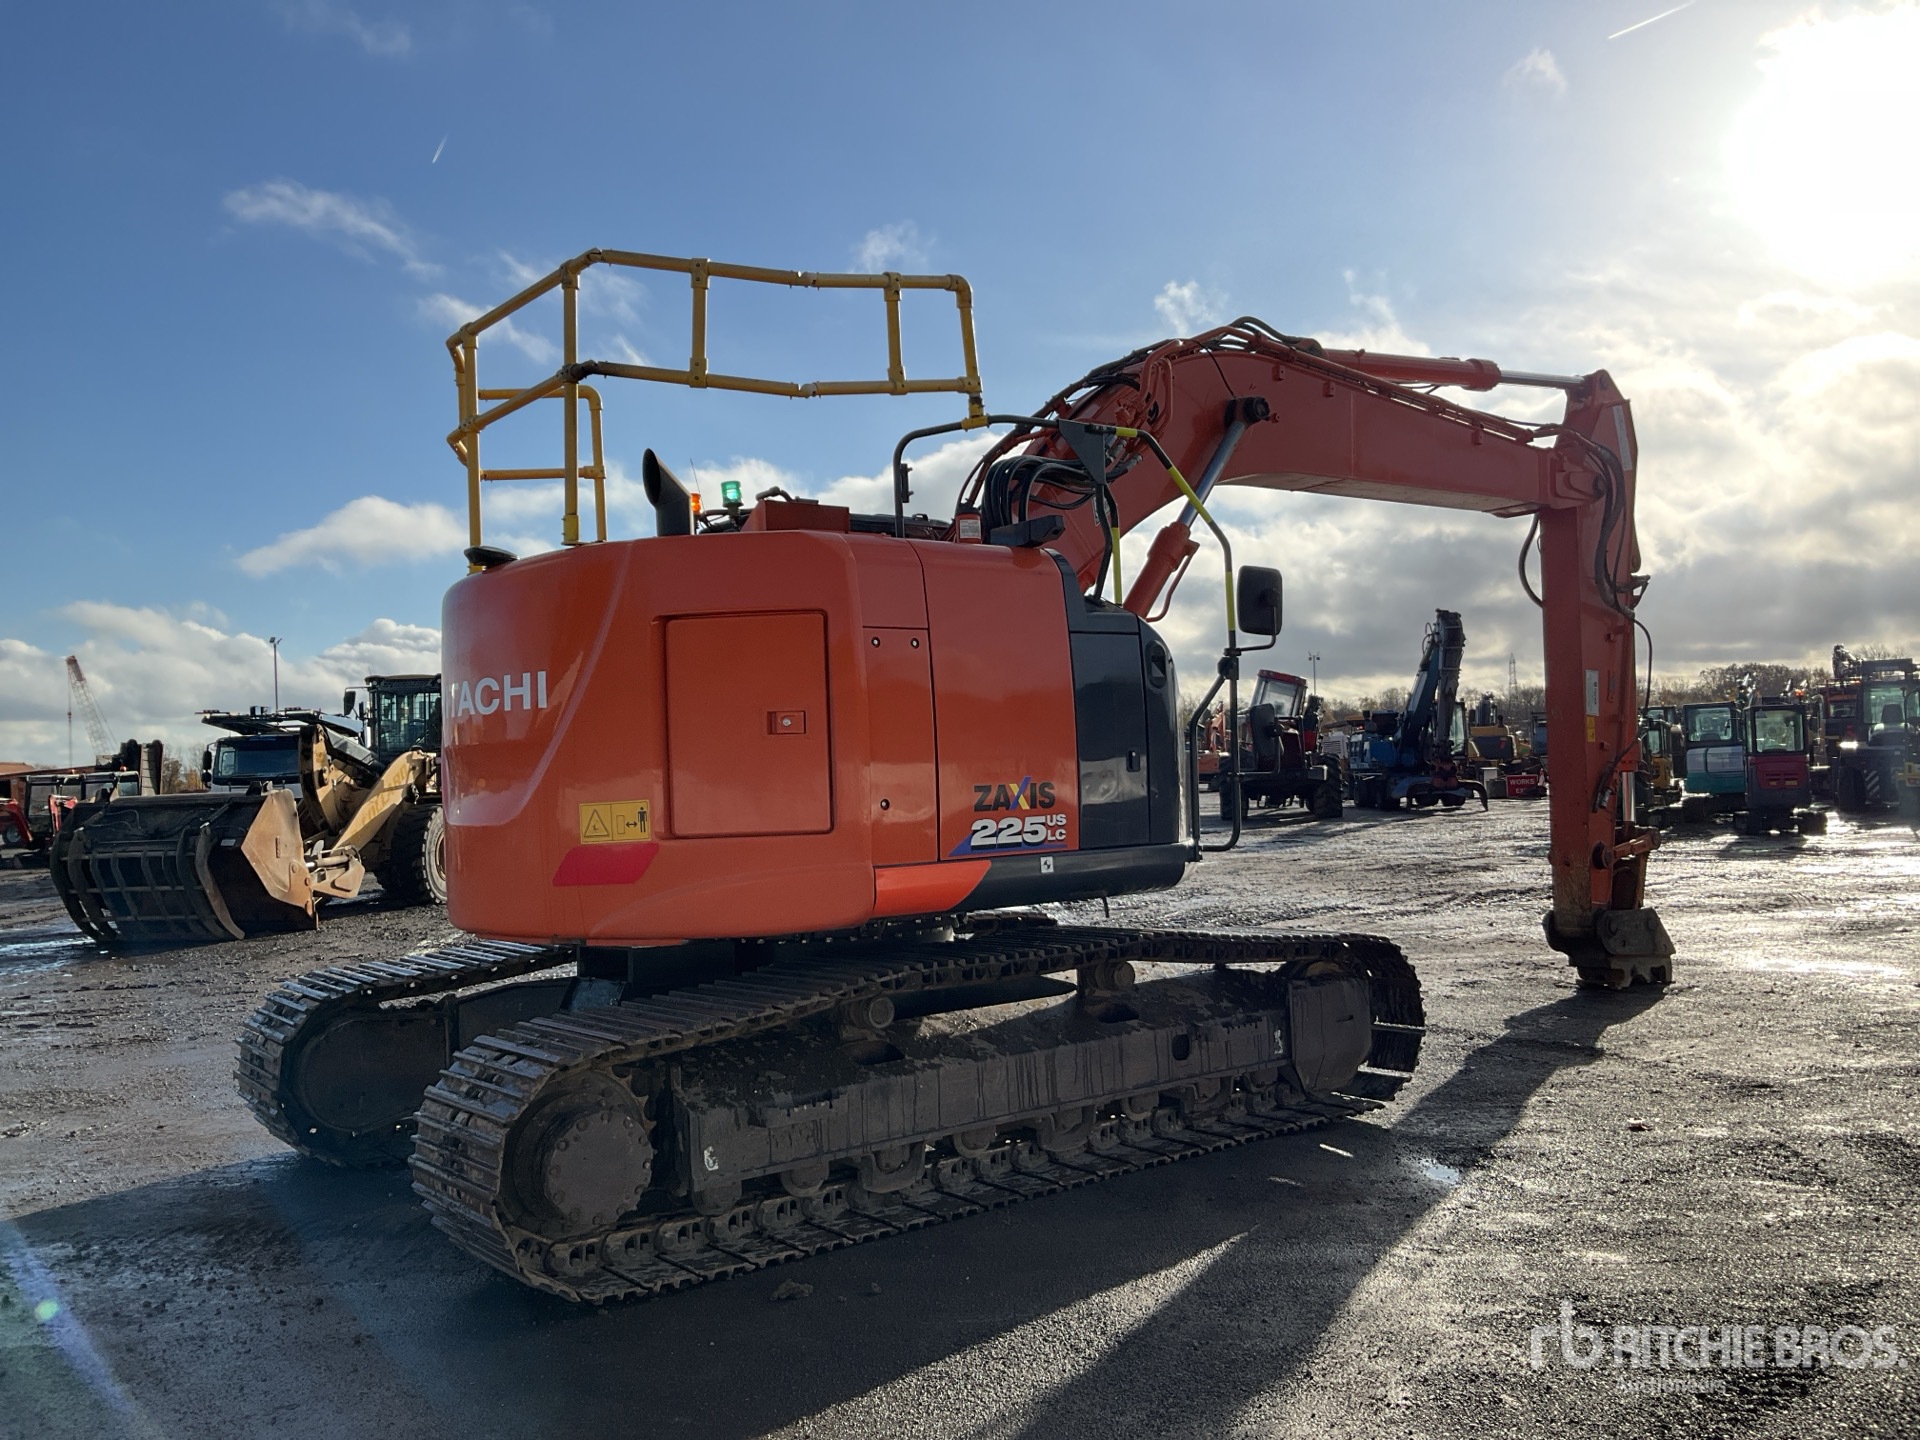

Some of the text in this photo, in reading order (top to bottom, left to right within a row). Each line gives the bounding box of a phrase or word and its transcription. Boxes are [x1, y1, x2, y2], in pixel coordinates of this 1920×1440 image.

[443, 671, 547, 719] ITACHI
[974, 776, 1055, 812] ZAXIS
[970, 813, 1067, 848] 225 US
[1047, 828, 1067, 841] LC
